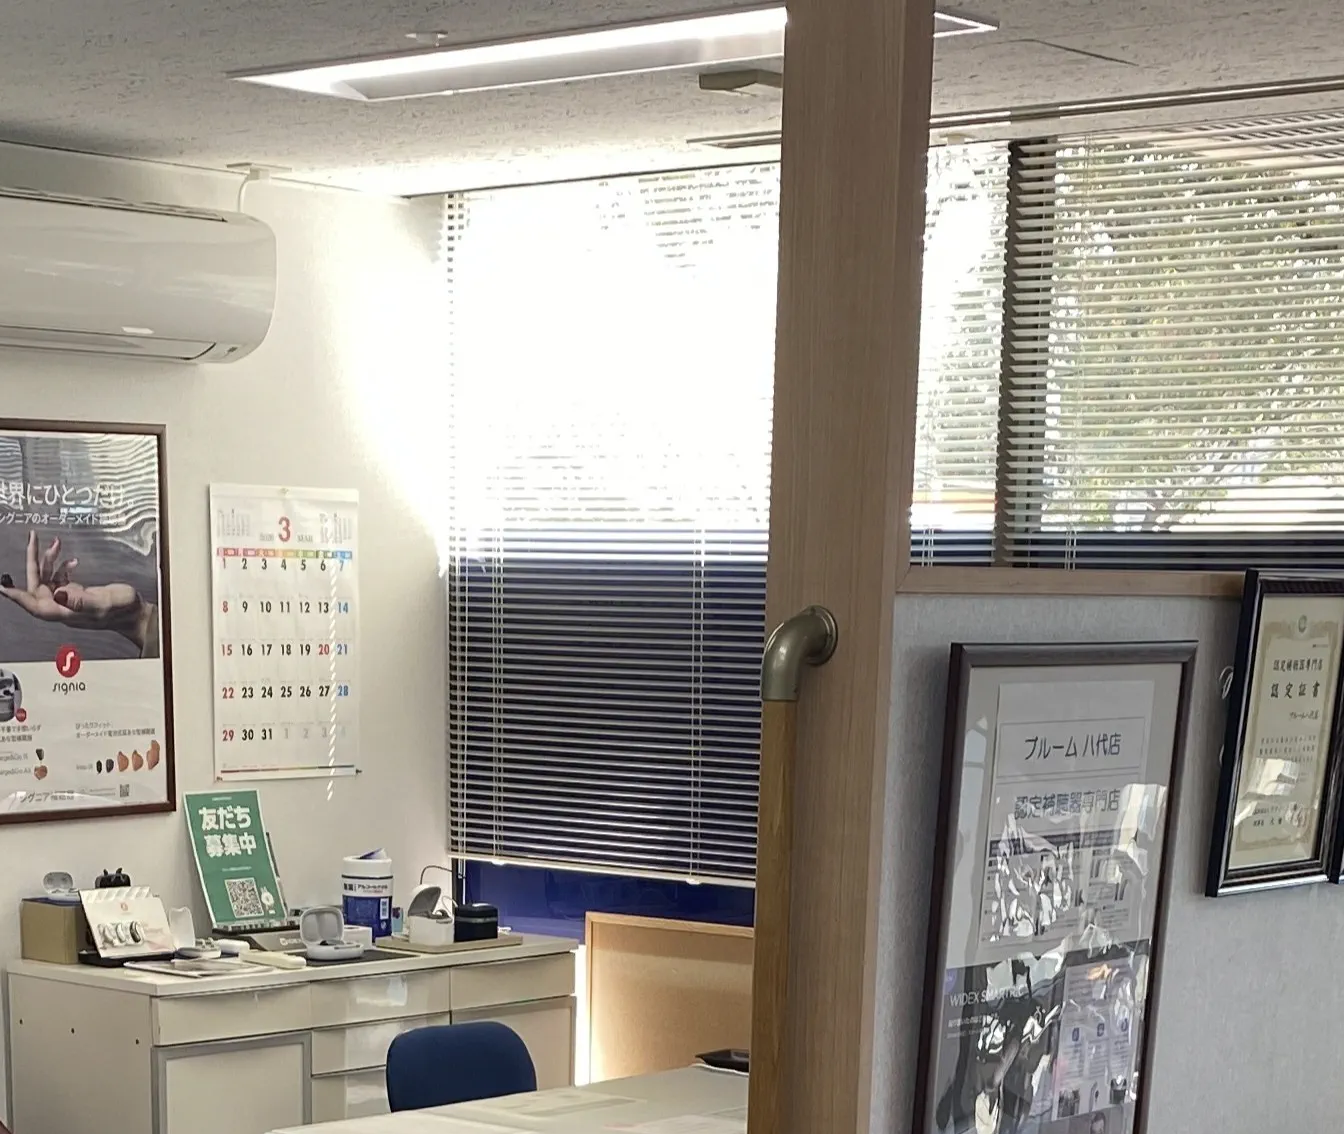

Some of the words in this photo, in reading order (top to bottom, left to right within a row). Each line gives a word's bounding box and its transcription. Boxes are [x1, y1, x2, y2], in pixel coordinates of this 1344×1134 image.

[278, 516, 291, 542] 3
[222, 558, 227, 569] 1
[242, 558, 248, 570] 2
[261, 558, 267, 570] 3
[281, 559, 287, 571] 4
[300, 559, 306, 571] 5
[320, 559, 326, 571] 6
[222, 601, 229, 613] 8
[242, 601, 248, 613] 9
[260, 601, 272, 613] 10
[280, 601, 290, 613] 11
[299, 601, 310, 613] 12
[318, 602, 329, 613] 13
[338, 602, 349, 613] 14
[221, 644, 233, 656] 15
[241, 644, 253, 656] 16
[261, 644, 272, 656] 17
[280, 644, 292, 656] 18
[299, 644, 311, 655] 19
[318, 644, 330, 655] 20
[337, 644, 348, 655] 21
[52, 681, 86, 695] signia
[222, 687, 234, 699] 22
[241, 687, 254, 699] 23
[261, 686, 273, 698] 24
[280, 686, 292, 698] 25
[299, 686, 311, 698] 26
[318, 685, 330, 697] 27
[337, 685, 349, 697] 28
[222, 729, 234, 742] 29
[241, 729, 254, 741] 30
[261, 728, 273, 741] 31
[1024, 734, 1078, 760] ブルーム
[1082, 732, 1122, 757] 八代店
[198, 804, 252, 831] 友だち
[203, 832, 257, 858] 募集中
[950, 989, 980, 1007] WIDEX
